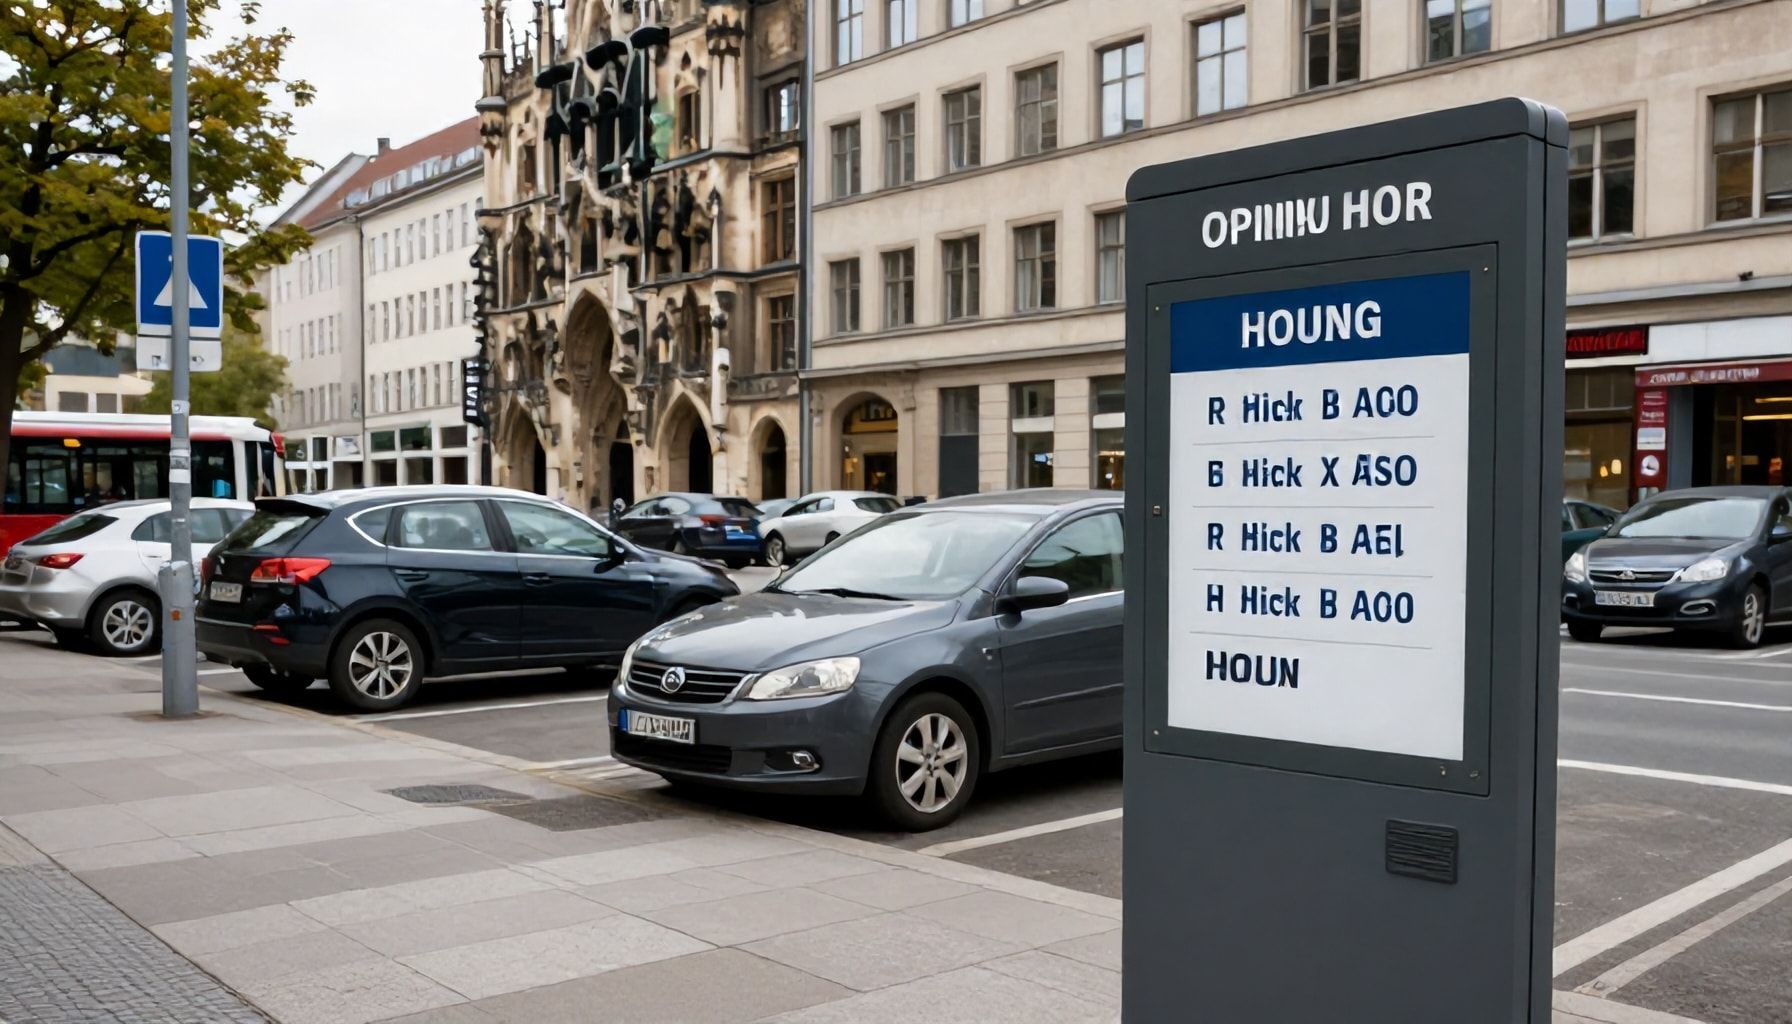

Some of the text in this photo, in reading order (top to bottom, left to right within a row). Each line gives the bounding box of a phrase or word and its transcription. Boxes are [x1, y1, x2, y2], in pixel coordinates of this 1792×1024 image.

[1342, 182, 1432, 230] HOR
[1241, 300, 1381, 349] HOUNG
[1208, 397, 1225, 425] R
[1322, 389, 1339, 420] B
[1242, 457, 1303, 488] Hick
[1320, 457, 1339, 487] X
[1207, 523, 1224, 551] R
[1242, 522, 1301, 553] Hick
[1320, 524, 1338, 553] B
[1241, 586, 1300, 617] Hick
[1320, 588, 1337, 619] B
[1206, 651, 1299, 688] HOUN
